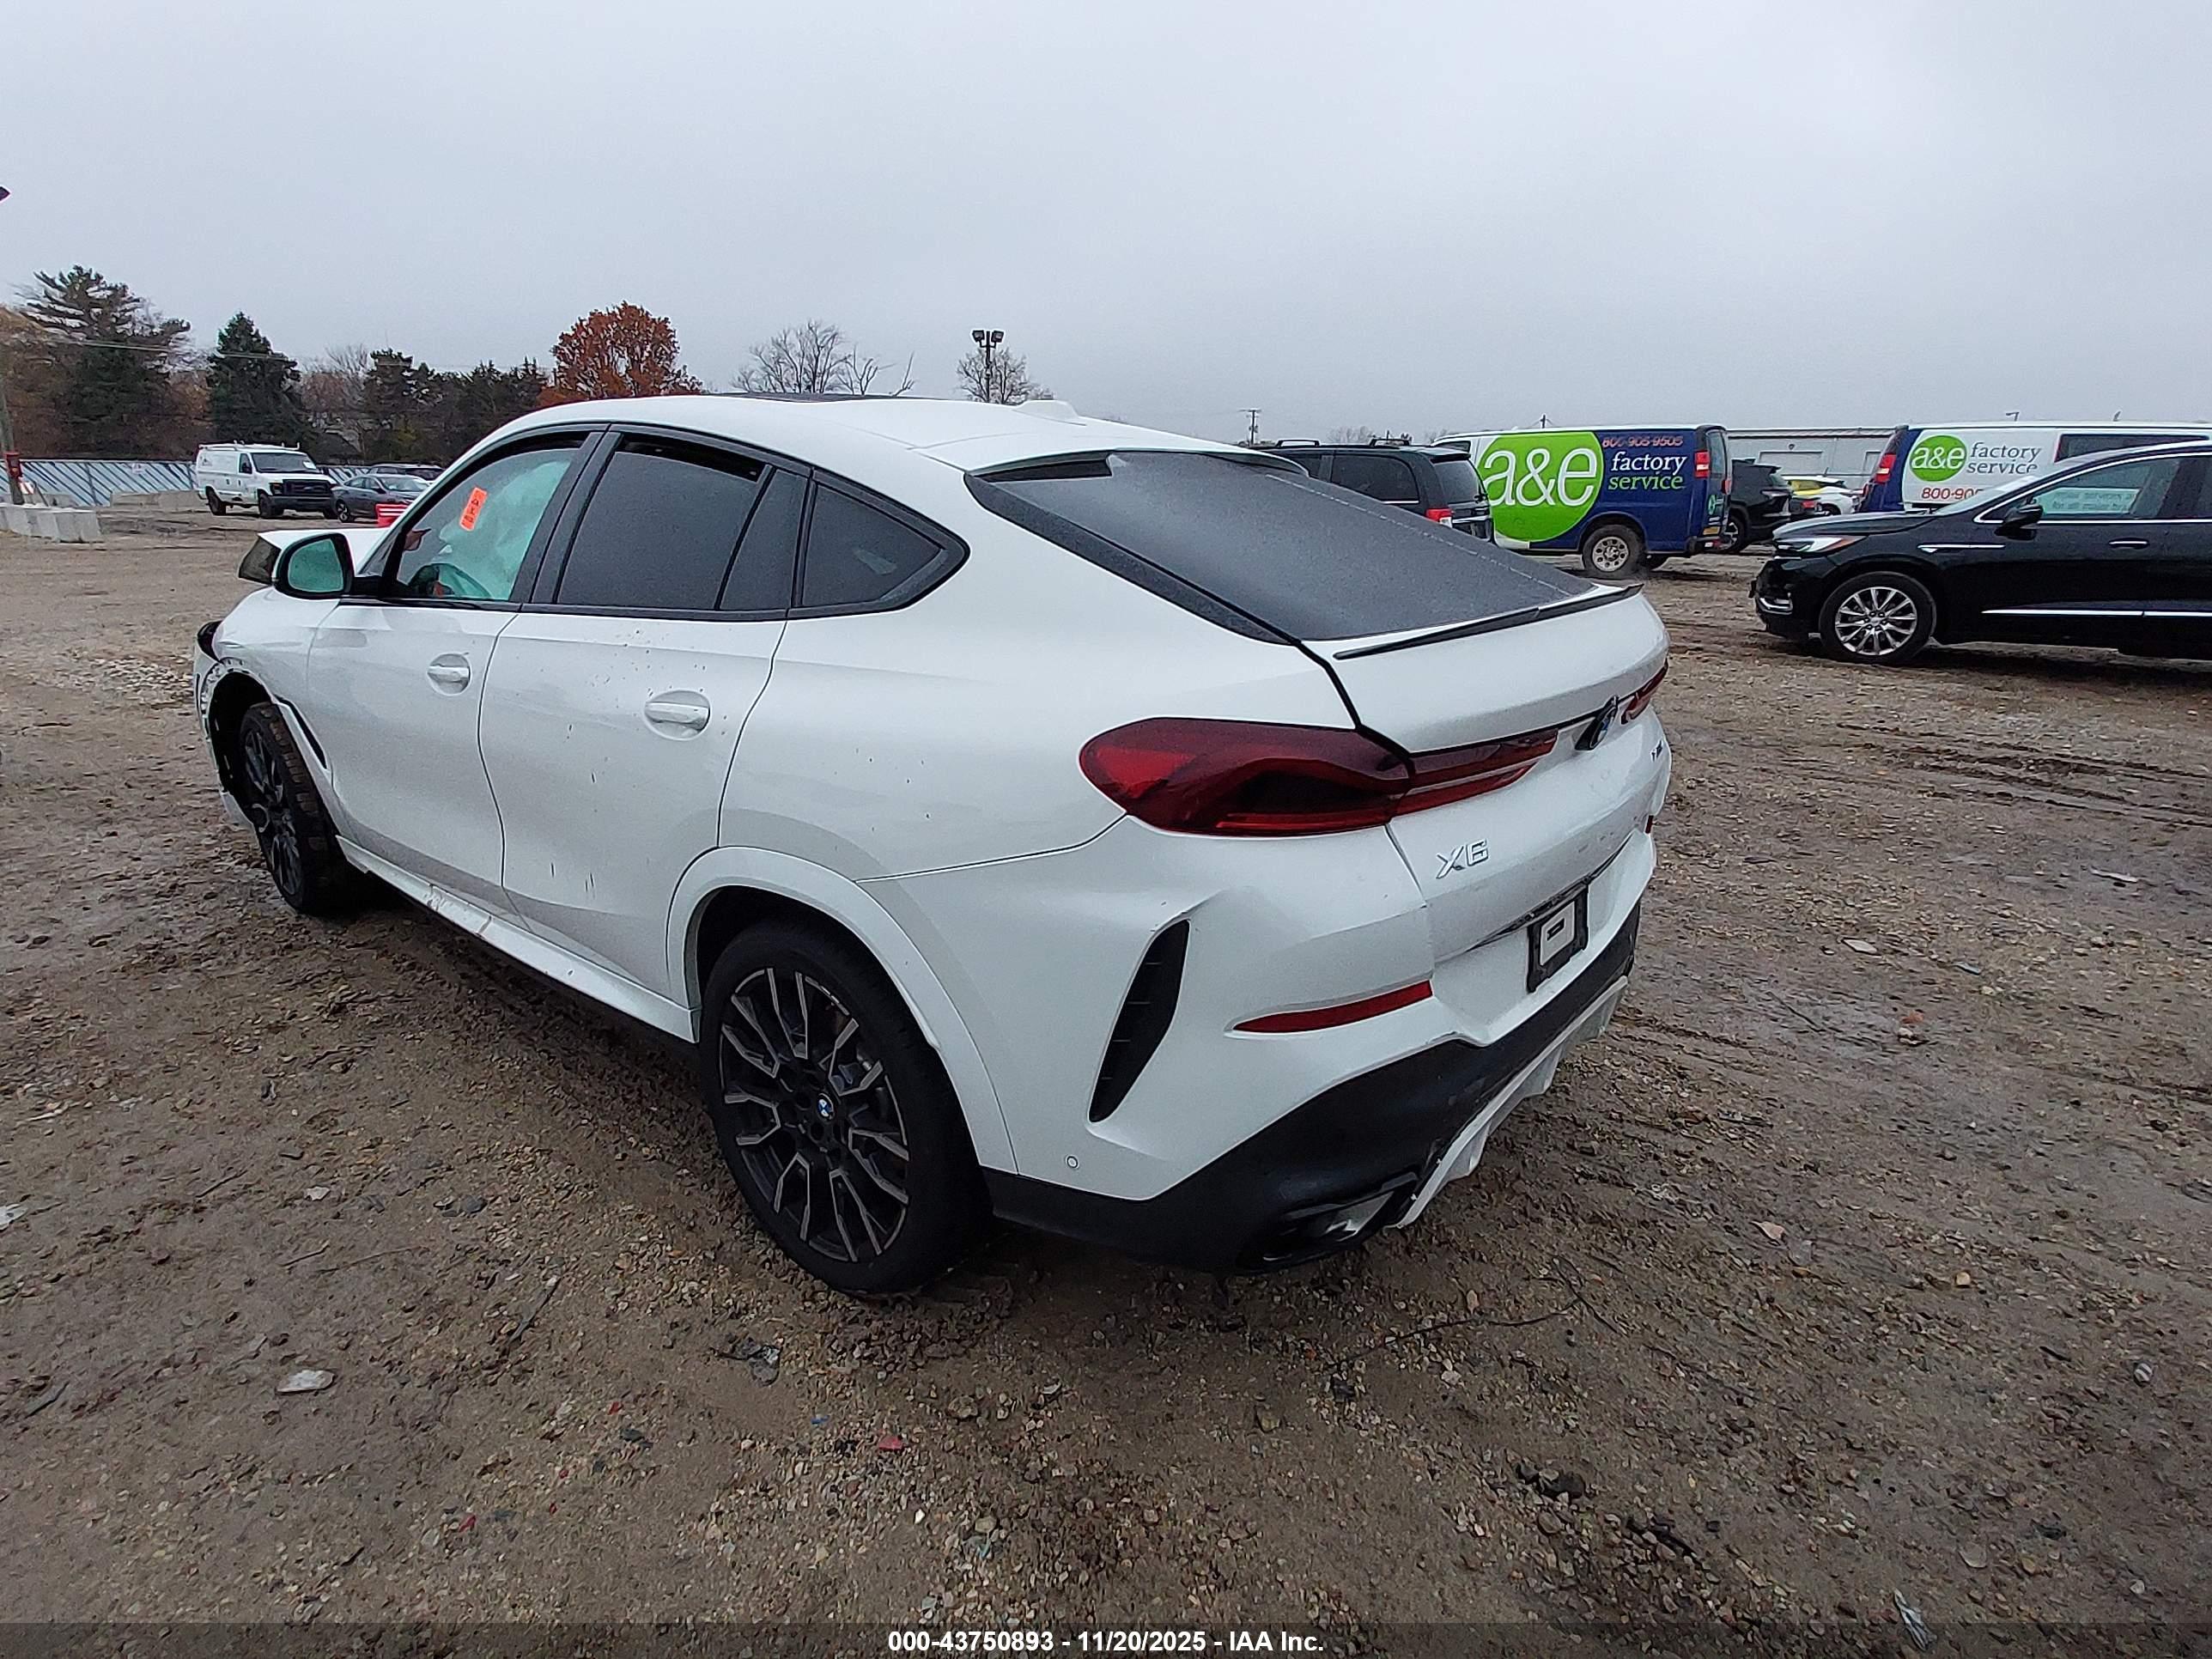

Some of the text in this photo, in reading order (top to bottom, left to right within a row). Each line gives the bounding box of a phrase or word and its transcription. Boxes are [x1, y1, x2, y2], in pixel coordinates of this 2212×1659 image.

[1911, 446, 1965, 469] a&e
[1970, 441, 2041, 463] factory
[1611, 451, 1687, 476] factory
[1966, 459, 2038, 474] service
[1484, 448, 1598, 507] a&e
[1608, 475, 1686, 490] service
[1922, 487, 1983, 500] 800-90
[1435, 838, 1489, 879] X6
